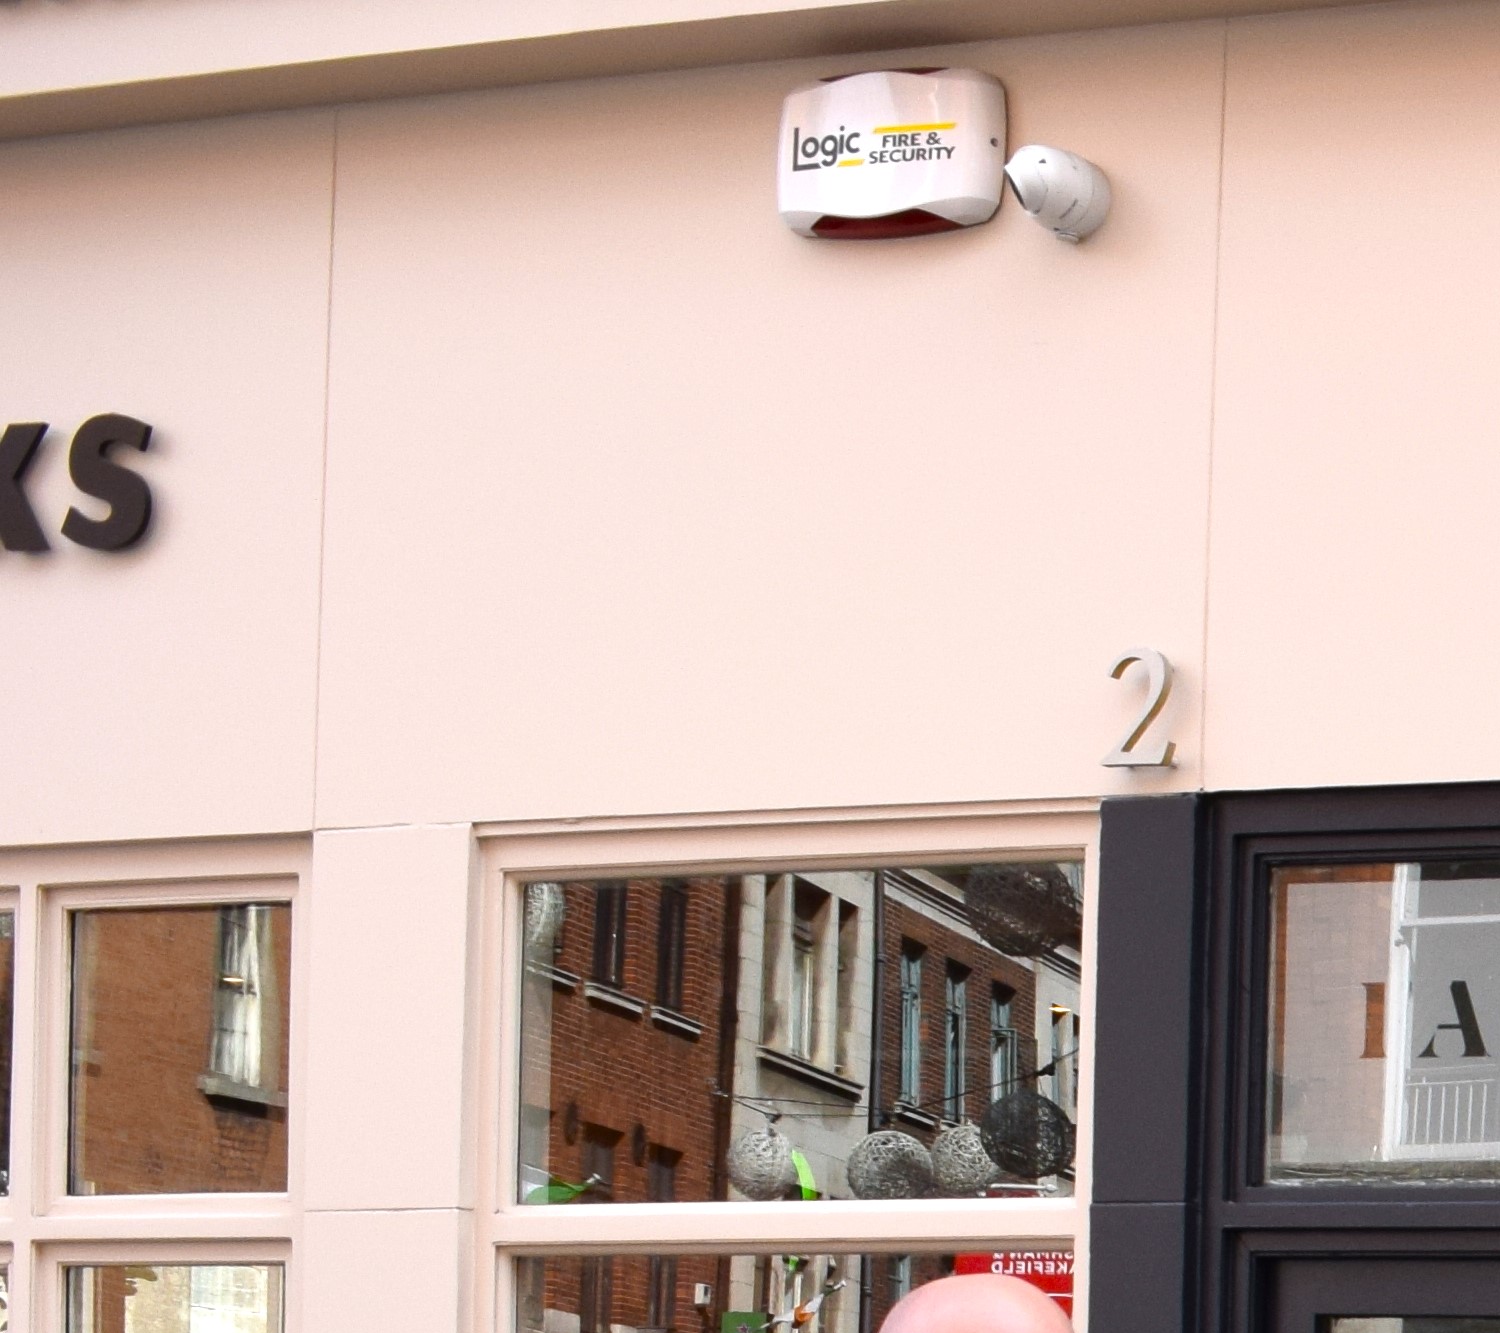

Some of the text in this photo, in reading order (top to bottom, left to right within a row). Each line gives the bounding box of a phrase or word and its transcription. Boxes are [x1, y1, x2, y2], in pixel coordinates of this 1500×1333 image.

[793, 126, 861, 171] Logic
[869, 147, 955, 164] SECURITY
[882, 132, 941, 148] FIRE &
[1101, 648, 1178, 768] 2
